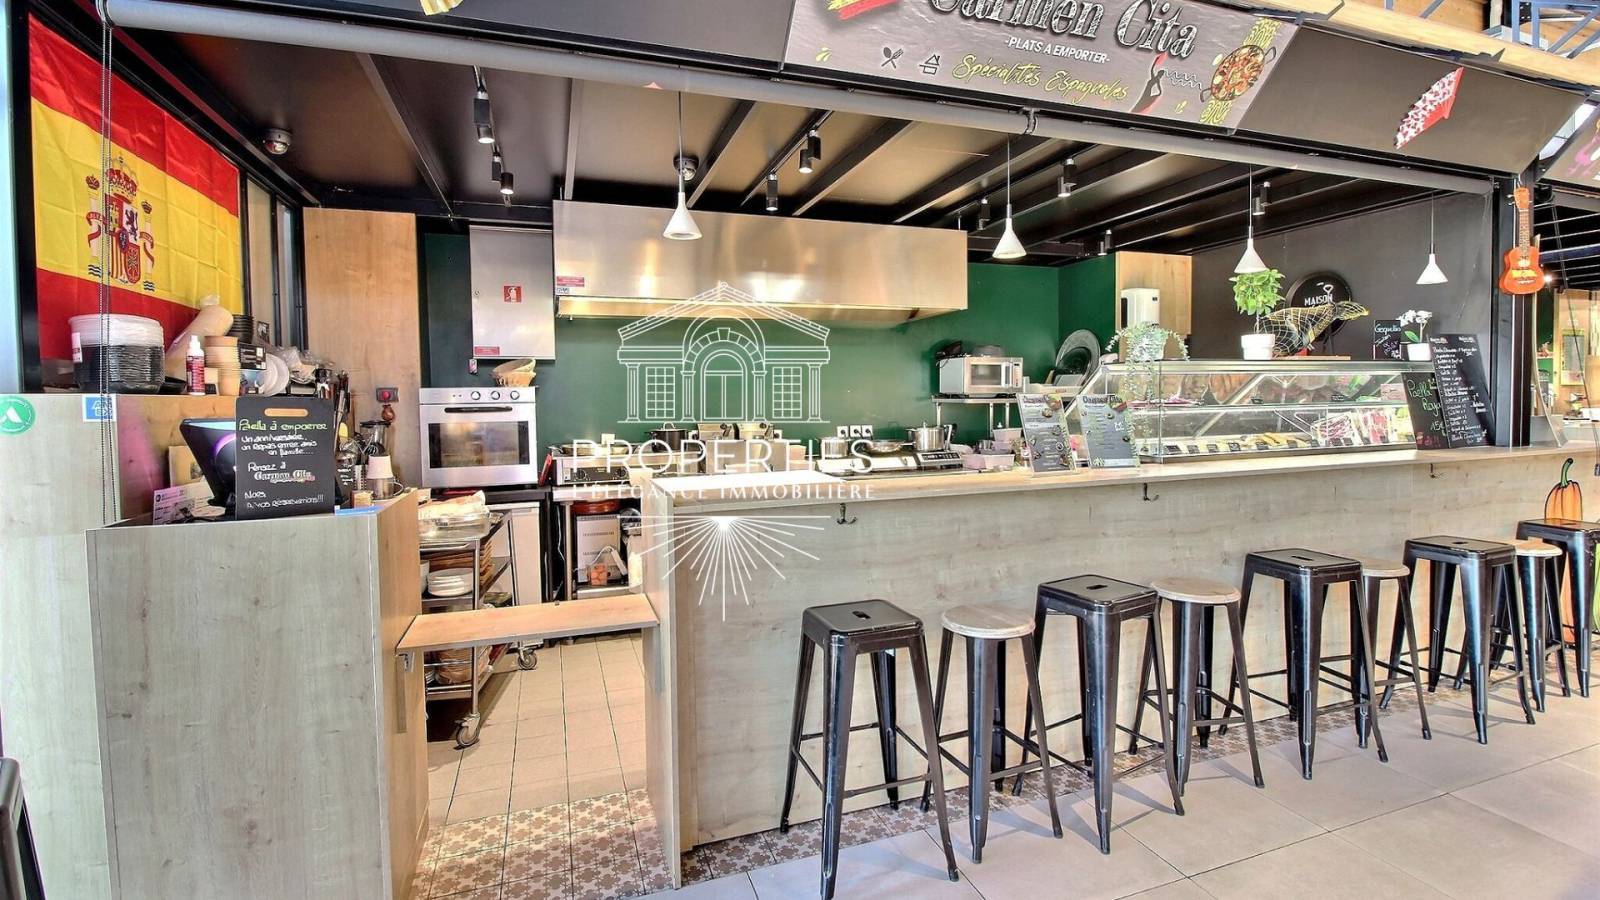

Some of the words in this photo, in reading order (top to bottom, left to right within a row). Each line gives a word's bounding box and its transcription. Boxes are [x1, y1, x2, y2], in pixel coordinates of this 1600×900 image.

[929, 0, 1104, 38] armen
[1116, 0, 1198, 58] Cita
[952, 54, 1040, 85] Spécialités
[1044, 70, 1128, 104] Espagnoles
[1304, 293, 1333, 306] MAISON
